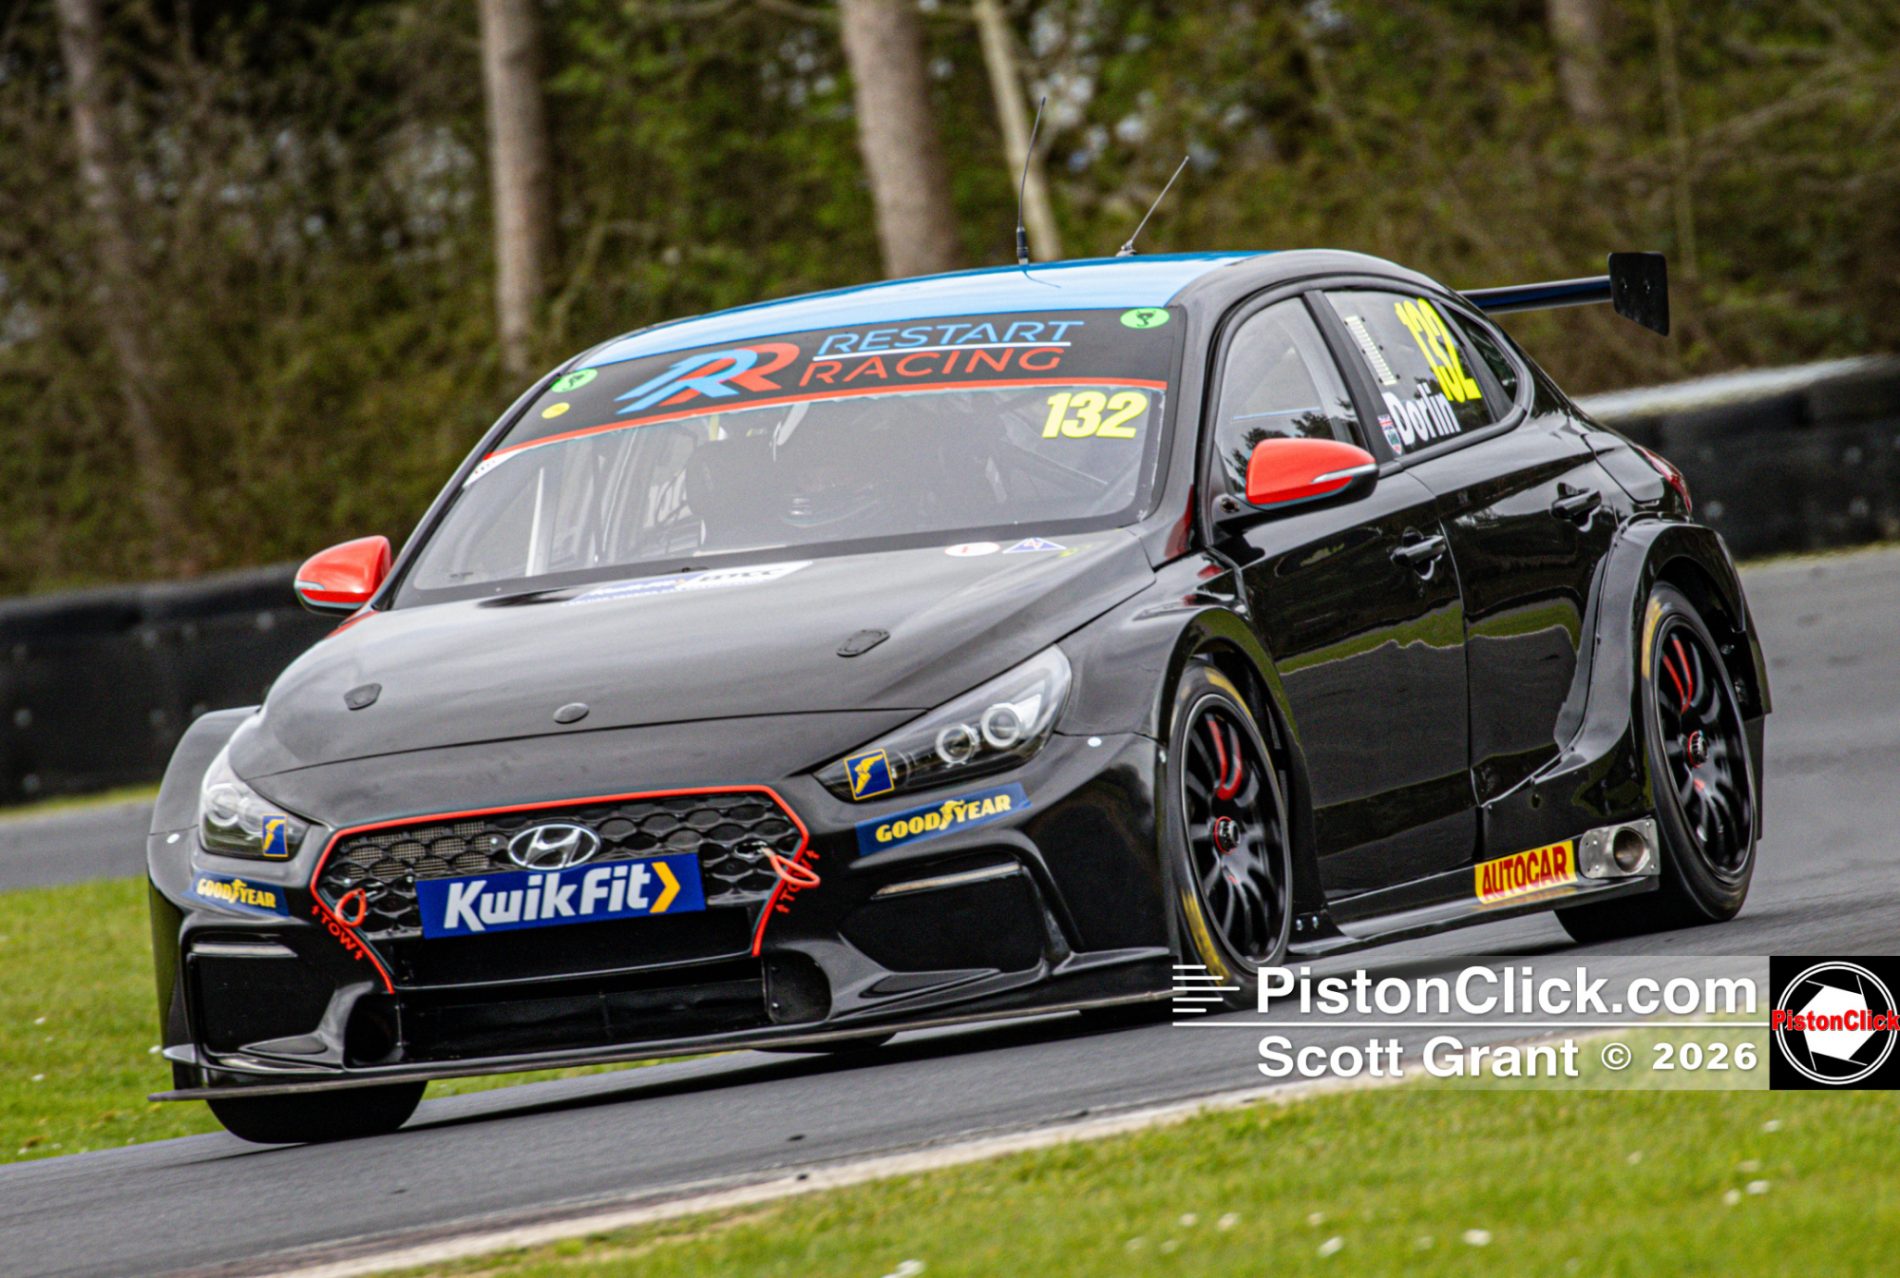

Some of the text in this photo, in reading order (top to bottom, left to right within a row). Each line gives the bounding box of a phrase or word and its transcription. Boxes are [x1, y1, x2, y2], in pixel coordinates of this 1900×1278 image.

[817, 320, 1085, 356] RESTART
[1394, 298, 1482, 403] 132
[799, 347, 1065, 387] RACING
[1042, 391, 1148, 439] 132
[1381, 382, 1461, 446] Dorlin
[875, 794, 1012, 843] GOODYEAR
[196, 878, 277, 909] GOODYEAR
[1482, 845, 1570, 901] AUTOCAR
[321, 911, 357, 950] TOW
